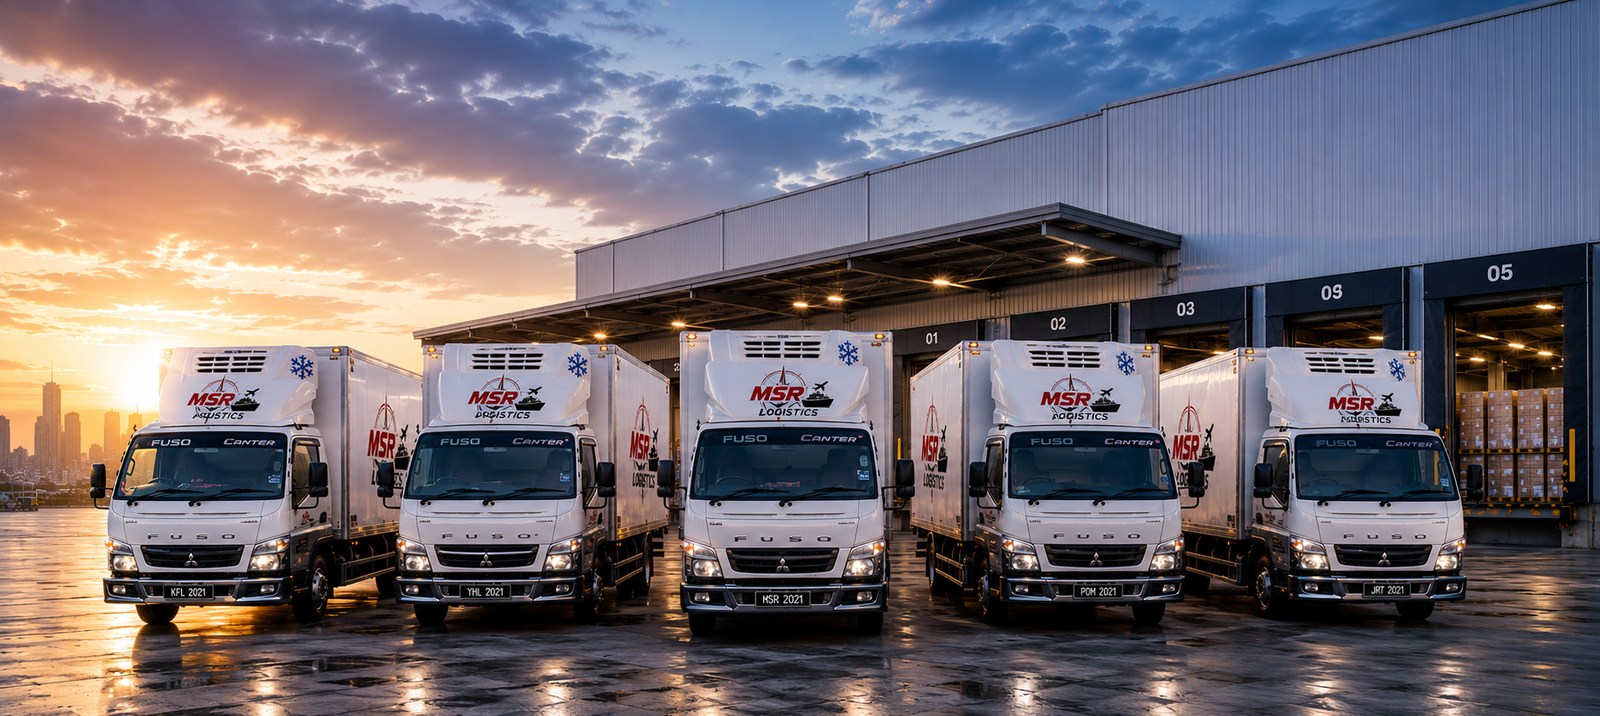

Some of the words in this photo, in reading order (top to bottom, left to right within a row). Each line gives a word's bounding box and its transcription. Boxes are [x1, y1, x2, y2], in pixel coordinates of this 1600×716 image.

[1487, 263, 1513, 282] 05
[1177, 301, 1195, 317] 03
[1050, 316, 1066, 331] 02
[925, 332, 938, 345] 01
[187, 393, 235, 406] MSR
[467, 391, 519, 405] MSR
[750, 386, 805, 402] MSR
[1040, 391, 1091, 406] MSR
[1328, 396, 1375, 410] MSR
[151, 438, 191, 447] FUSO
[367, 429, 396, 459] MSR
[440, 438, 480, 446] FUSO
[629, 430, 650, 460] MSR
[723, 434, 768, 443] FUSO
[1030, 437, 1073, 446] FUSO
[921, 435, 939, 462] MSR
[1172, 435, 1200, 461] MSR
[170, 587, 185, 597] KFL
[188, 587, 206, 597] 2021
[467, 587, 482, 597] YHL
[485, 587, 504, 597] 2021
[1080, 587, 1096, 597] POM
[1099, 587, 1117, 597] 2021
[1370, 585, 1384, 595] JRT
[1387, 585, 1404, 595] 2021
[762, 595, 780, 604] MSR
[783, 594, 803, 604] 2021
